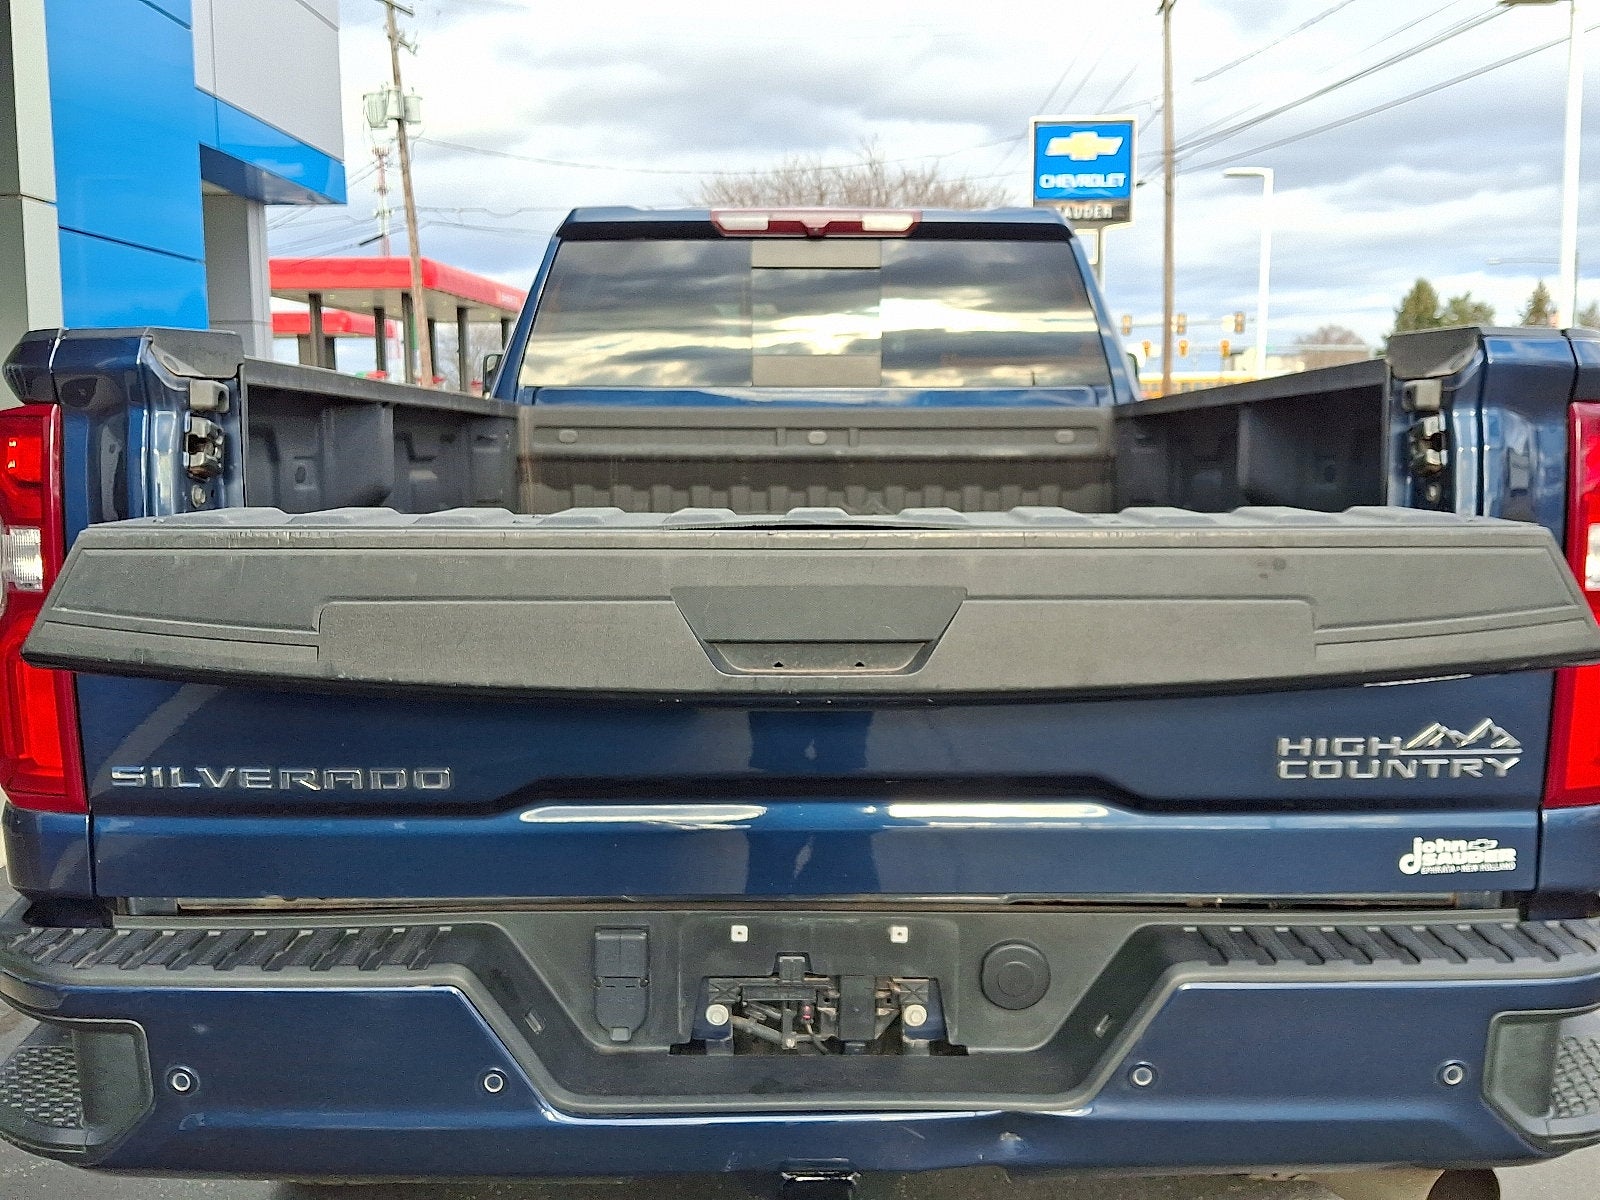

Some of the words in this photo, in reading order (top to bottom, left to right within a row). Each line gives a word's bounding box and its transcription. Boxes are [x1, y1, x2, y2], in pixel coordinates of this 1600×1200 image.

[1039, 173, 1127, 188] CHEVROLET
[1057, 204, 1113, 219] AUDER
[1277, 737, 1402, 756] HIGH
[1277, 757, 1521, 778] COUNTRY
[111, 765, 453, 791] SILVERADO
[1421, 848, 1517, 866] SAUDER
